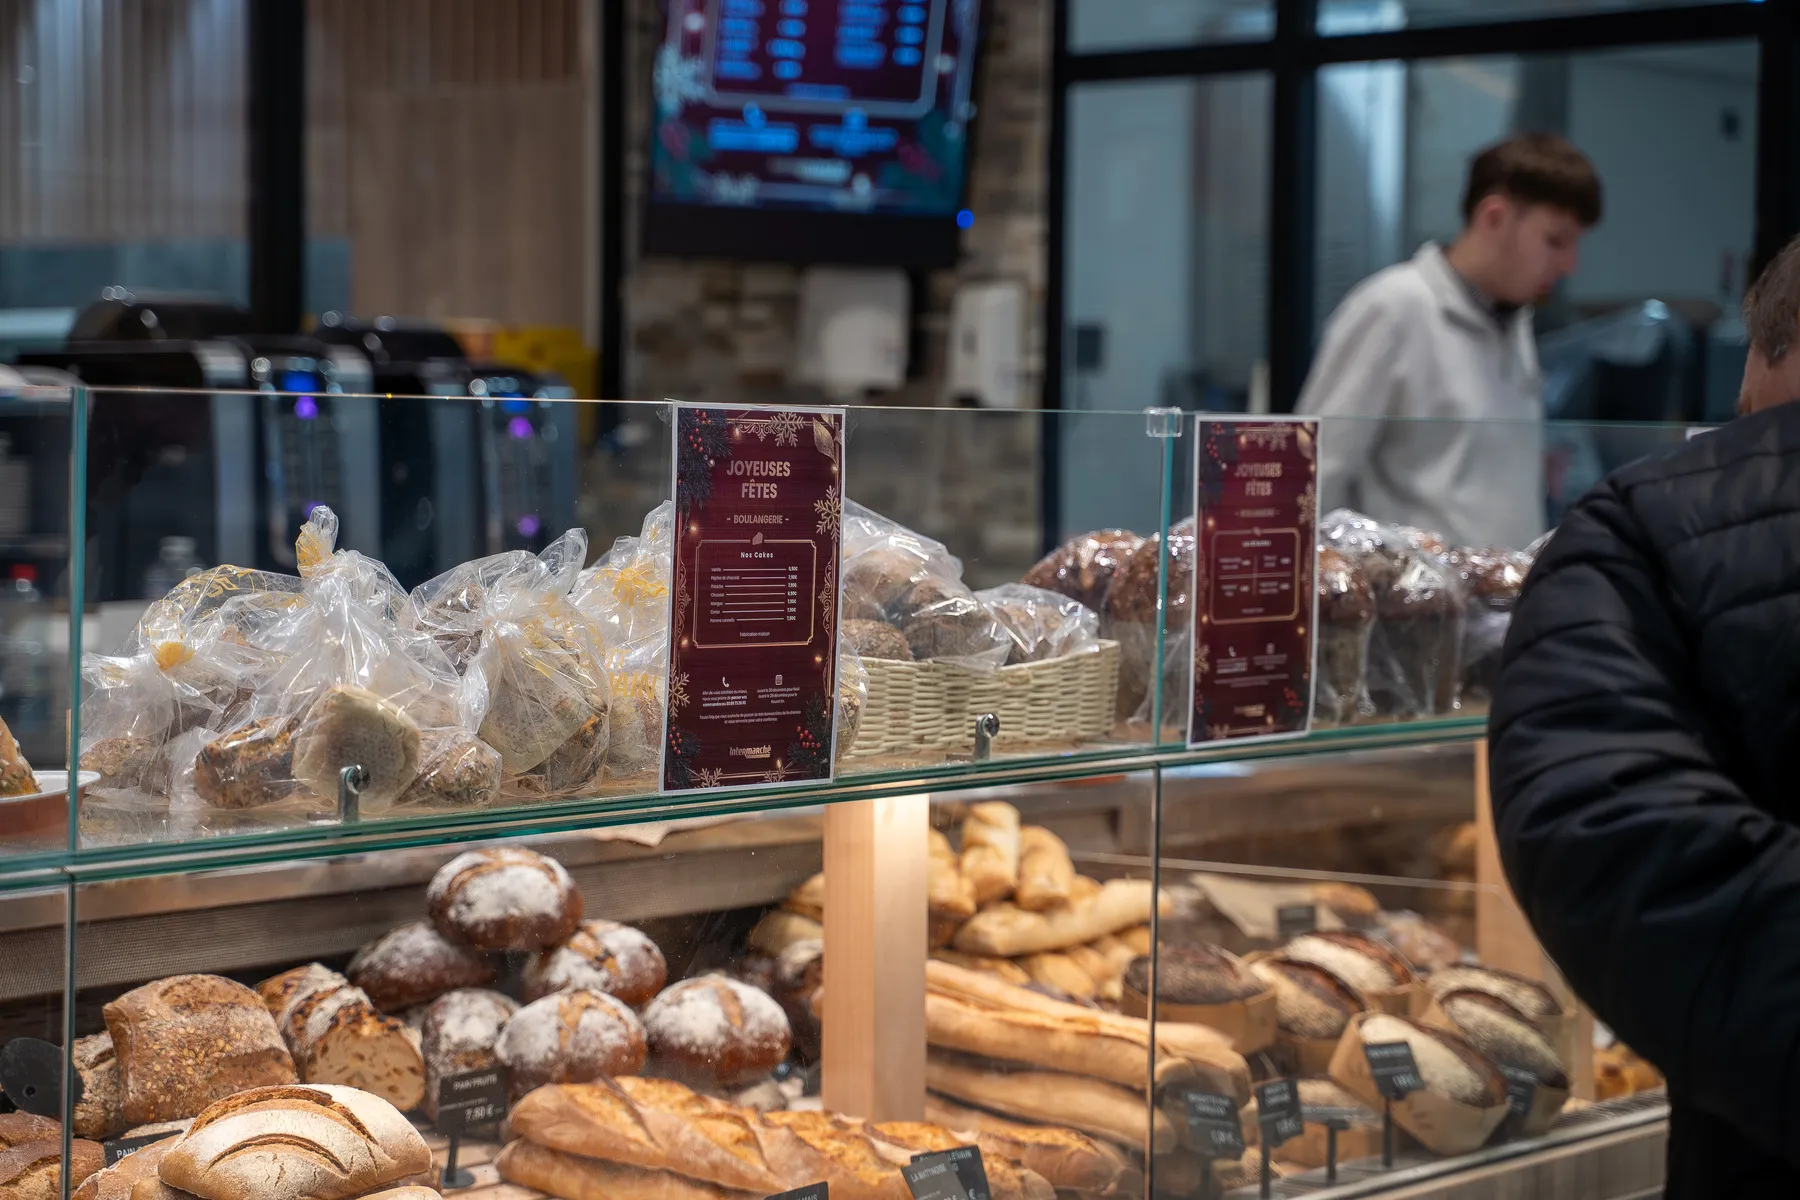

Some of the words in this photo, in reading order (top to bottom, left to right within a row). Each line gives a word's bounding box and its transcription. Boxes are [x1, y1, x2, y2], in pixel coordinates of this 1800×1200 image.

[726, 460, 791, 477] JOYEUSES
[741, 478, 778, 499] FÊTES
[733, 514, 783, 524] BOULANGERIE
[740, 551, 753, 559] Nos
[754, 551, 774, 559] Cakes
